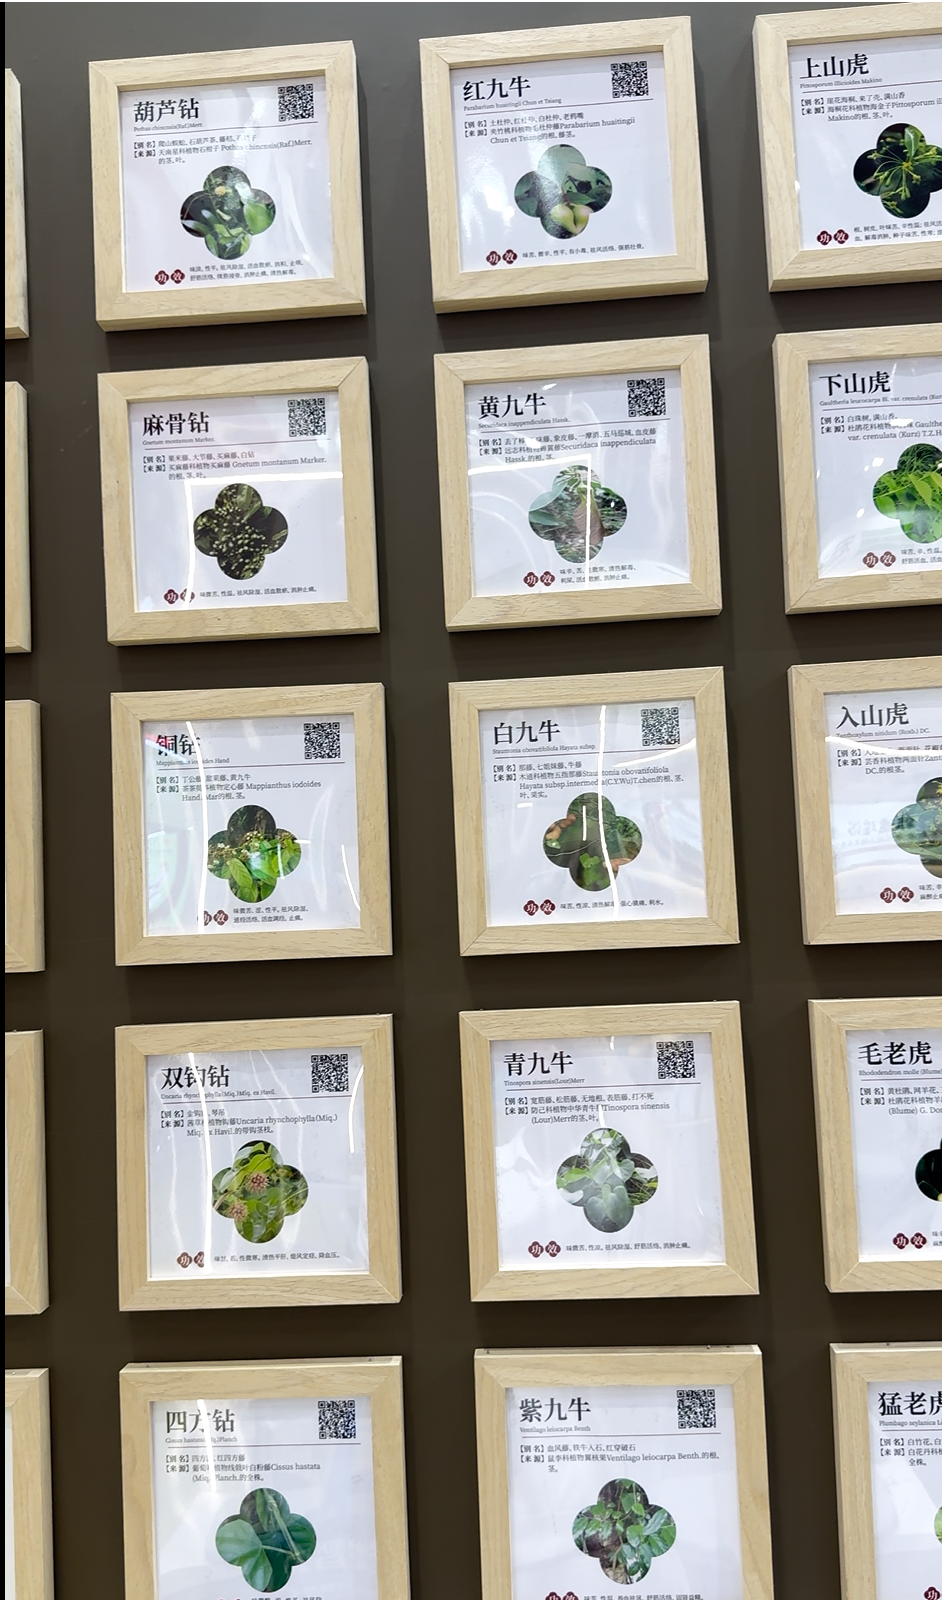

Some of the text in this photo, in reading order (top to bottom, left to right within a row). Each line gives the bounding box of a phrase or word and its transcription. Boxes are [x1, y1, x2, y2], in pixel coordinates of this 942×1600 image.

[799, 52, 869, 80] 上山虎
[462, 75, 531, 102] 红九牛
[133, 96, 199, 123] 葫芦钻
[490, 136, 509, 145] Chun
[510, 135, 518, 143] et
[818, 370, 890, 396] 下山虎
[477, 391, 546, 419] 黄九牛
[142, 410, 209, 436] 麻骨钻
[847, 433, 861, 442] var.
[862, 431, 896, 441] crenulata
[232, 458, 260, 468] Gnetum
[261, 456, 299, 467] montanum
[835, 701, 909, 729] 入山虎
[493, 719, 560, 745] 白九牛
[246, 780, 290, 790] Mappianthus
[291, 779, 322, 788] iodoides
[519, 781, 544, 791] Hayata
[503, 1050, 573, 1076] 青九牛
[858, 1040, 932, 1066] 毛老虎
[161, 1064, 229, 1090] 双钩钻
[503, 1079, 531, 1087] Tinospora
[640, 1101, 670, 1110] sinensis
[888, 1106, 917, 1115] (Blume)
[919, 1106, 928, 1115] G.
[166, 1408, 235, 1433] 四方钻
[519, 1396, 591, 1422] 紫九牛
[295, 1461, 321, 1470] hastata
[642, 1452, 676, 1461] leiocarpa
